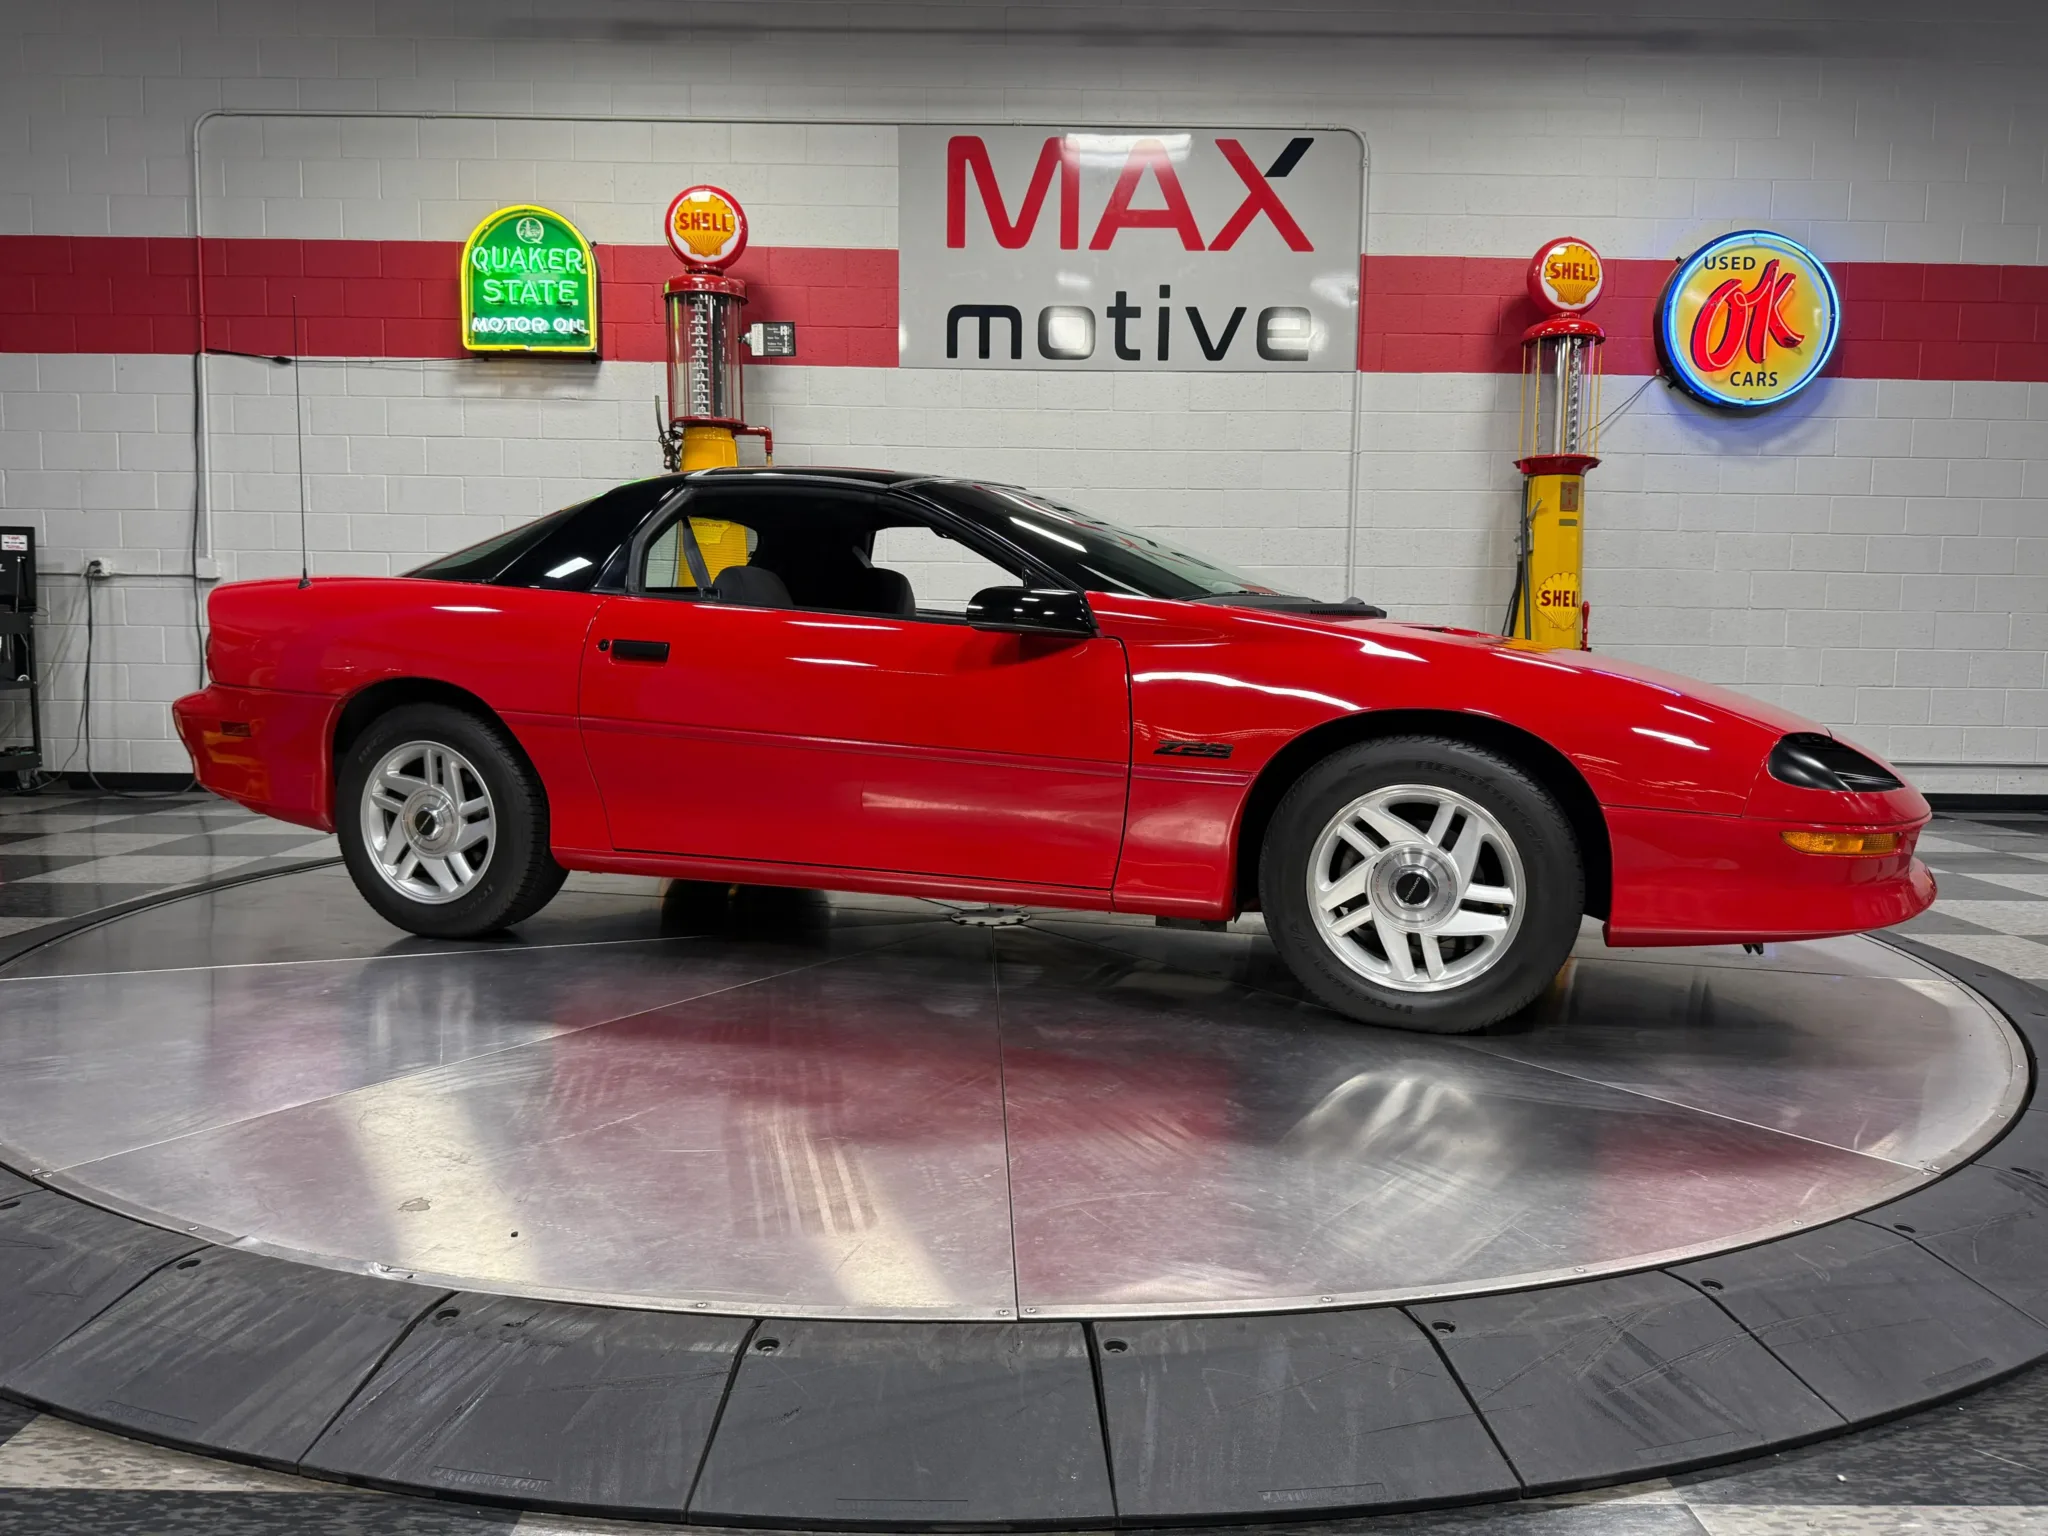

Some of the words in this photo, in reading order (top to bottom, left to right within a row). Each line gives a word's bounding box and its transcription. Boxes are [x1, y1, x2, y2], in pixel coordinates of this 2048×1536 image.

[946, 135, 1315, 252] MAX
[679, 212, 731, 233] SHELL
[471, 245, 584, 273] QUAKER
[1703, 256, 1756, 271] USED
[1550, 262, 1597, 283] SHELL
[482, 279, 579, 306] STATE
[472, 317, 546, 333] MOTOR
[552, 317, 588, 334] OIL
[946, 284, 1313, 362] motive
[1690, 259, 1805, 373] OK
[1730, 371, 1778, 387] CARS
[1541, 590, 1579, 608] SHEL
[1153, 739, 1234, 759] Z28
